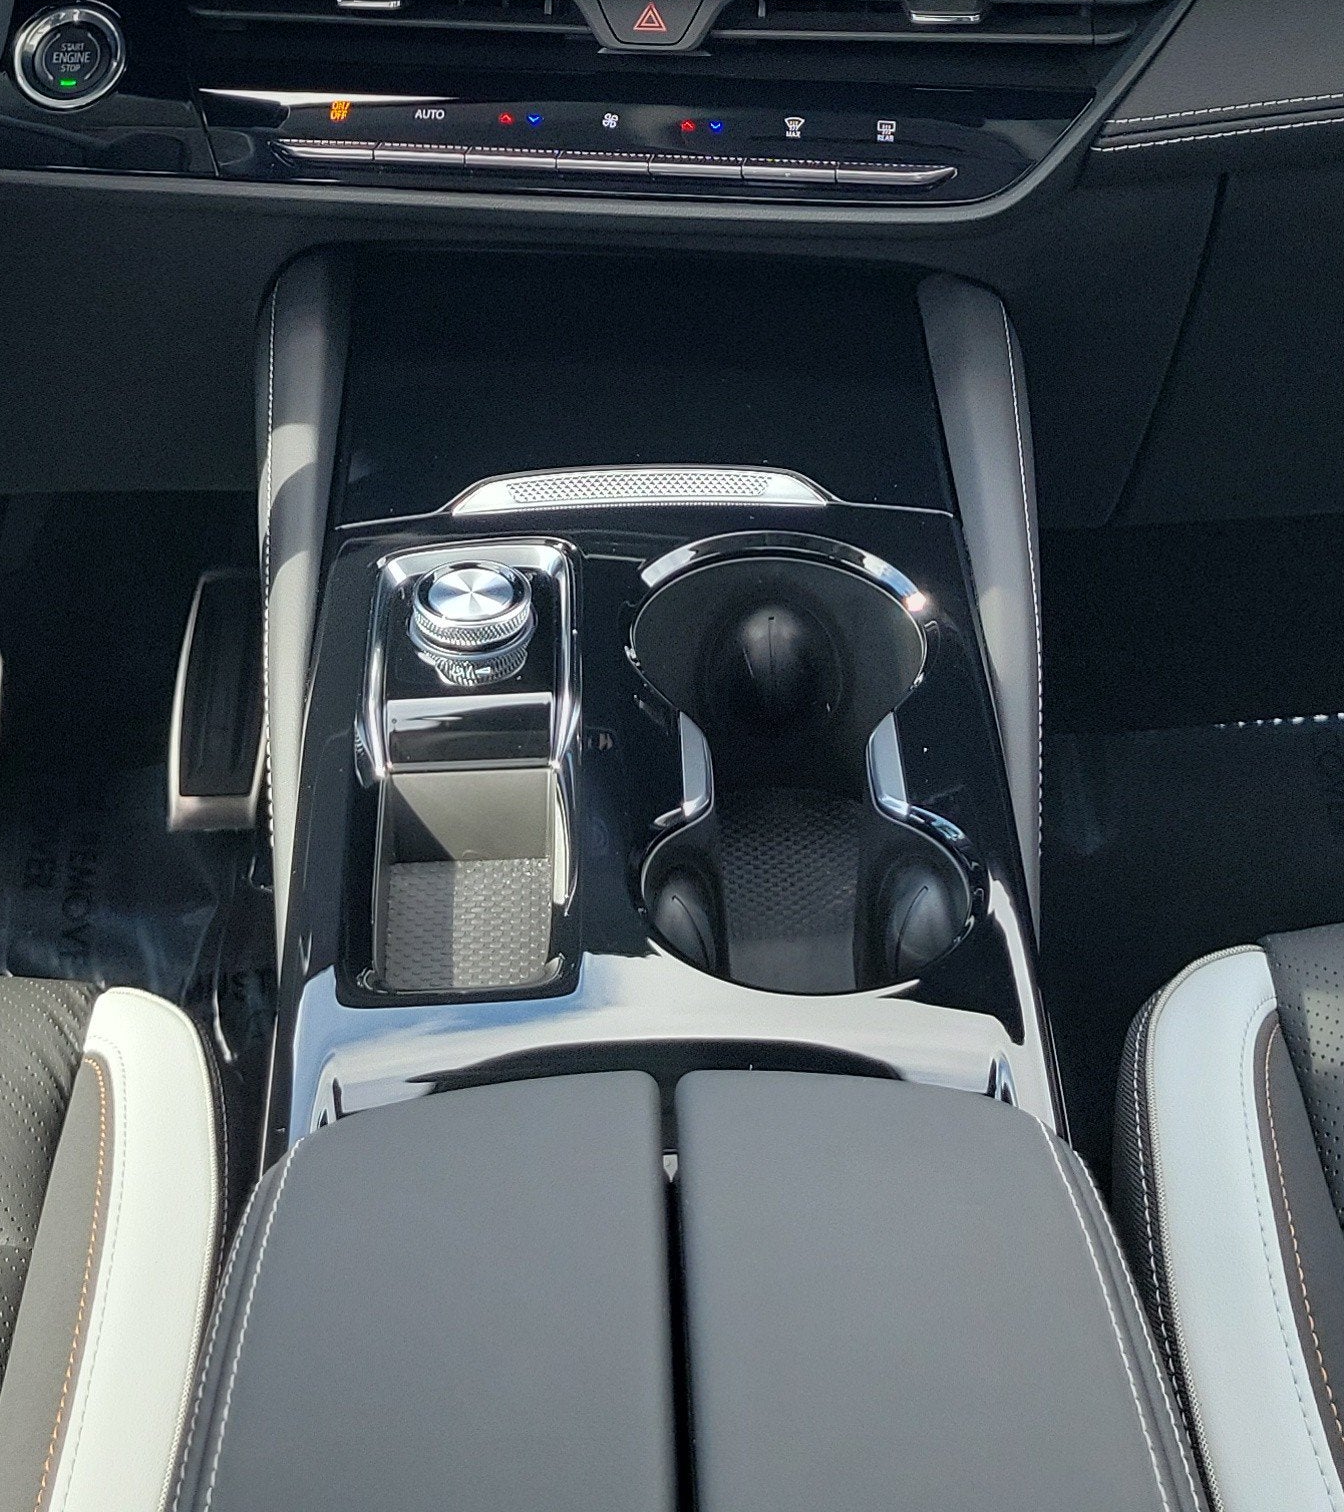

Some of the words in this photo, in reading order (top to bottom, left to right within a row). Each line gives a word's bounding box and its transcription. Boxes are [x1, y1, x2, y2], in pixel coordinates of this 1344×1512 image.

[61, 42, 85, 52] START
[52, 51, 91, 64] ENGINE
[61, 64, 82, 72] STOP
[415, 109, 445, 120] AUTO
